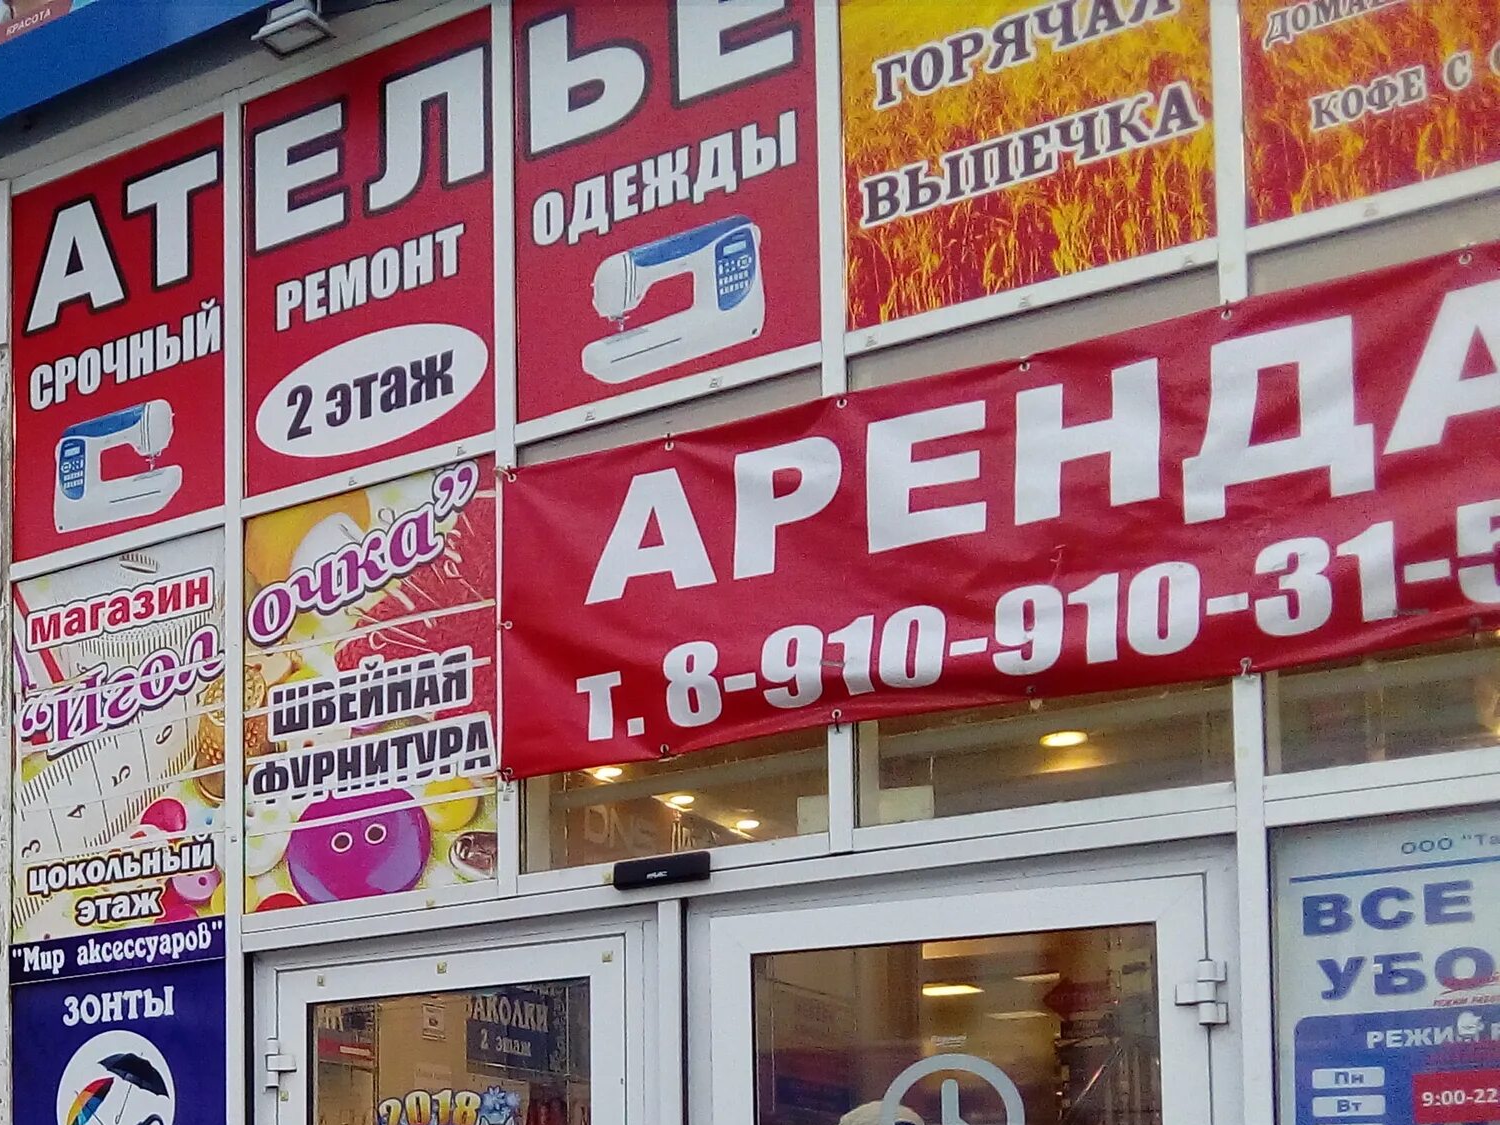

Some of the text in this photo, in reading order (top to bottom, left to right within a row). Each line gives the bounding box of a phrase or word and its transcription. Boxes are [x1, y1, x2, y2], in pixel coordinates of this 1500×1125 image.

[1311, 67, 1424, 130] КОФЕ
[863, 85, 1200, 226] ВЫПЕЧКА
[28, 109, 799, 411] СРОЧНЫЙ РЕМОНТ ОДЕЖДЫ
[287, 349, 454, 441] 2 этаж
[583, 281, 1500, 604] АРЕНДА
[30, 574, 210, 645] магазин
[273, 653, 467, 736] ШВЕЙНАЯ
[254, 720, 492, 804] ФУРНИТУРА
[1401, 838, 1452, 854] ООО
[1302, 880, 1475, 936] ВСЕ
[63, 986, 175, 1026] ЗОНТЫ
[1367, 1022, 1481, 1049] РЕЖИ
[1334, 1072, 1364, 1085] Пн
[1337, 1099, 1362, 1113] Вт
